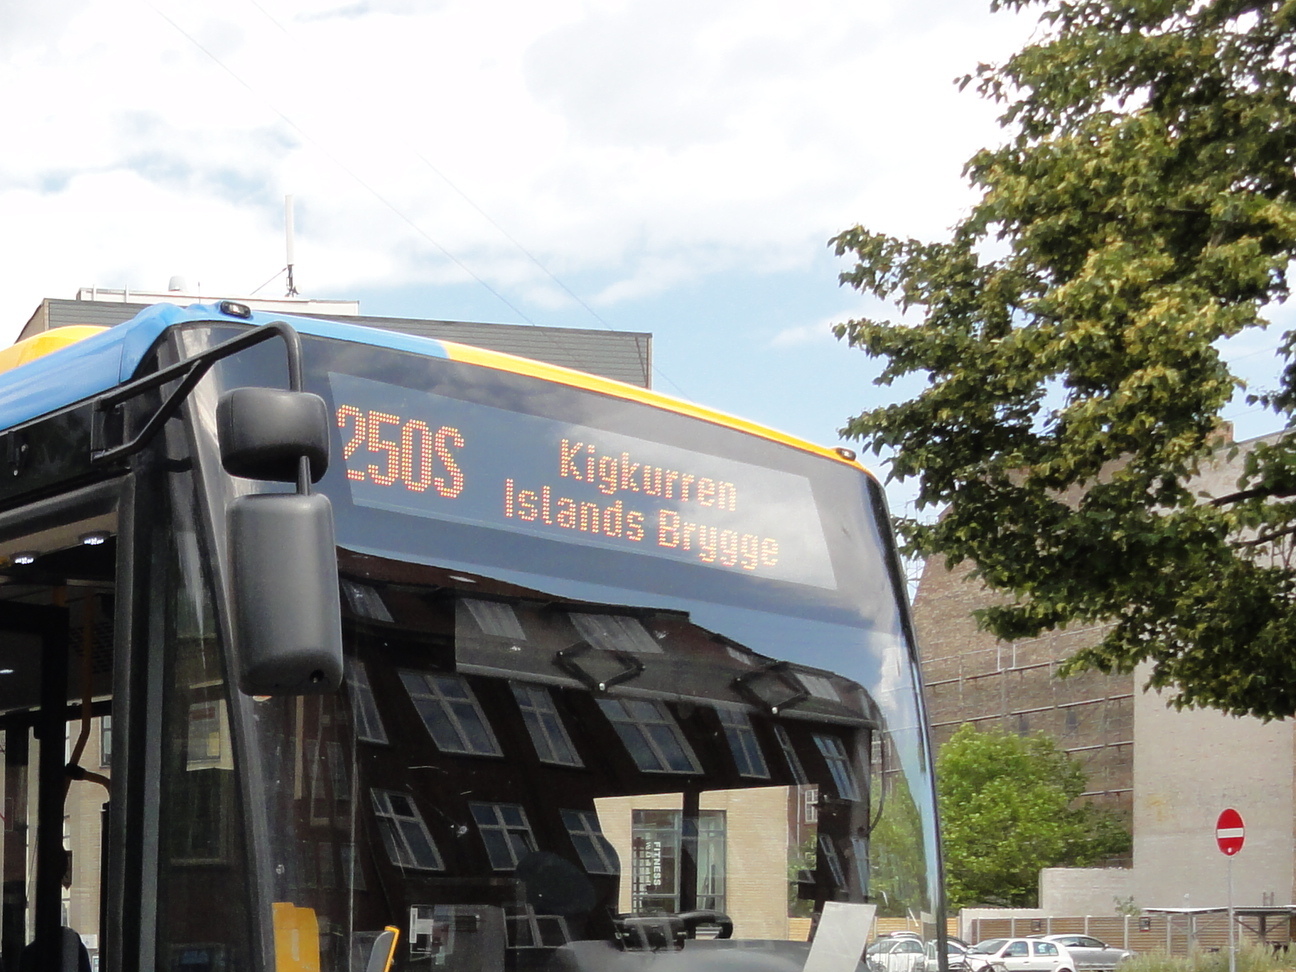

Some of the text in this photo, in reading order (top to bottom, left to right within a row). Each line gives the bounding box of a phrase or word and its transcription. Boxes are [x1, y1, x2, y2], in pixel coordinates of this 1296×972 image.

[335, 403, 465, 499] 250S
[559, 438, 737, 512] Kigkurren
[505, 478, 779, 570] Islands Brygge
[653, 841, 661, 886] FITNESS
